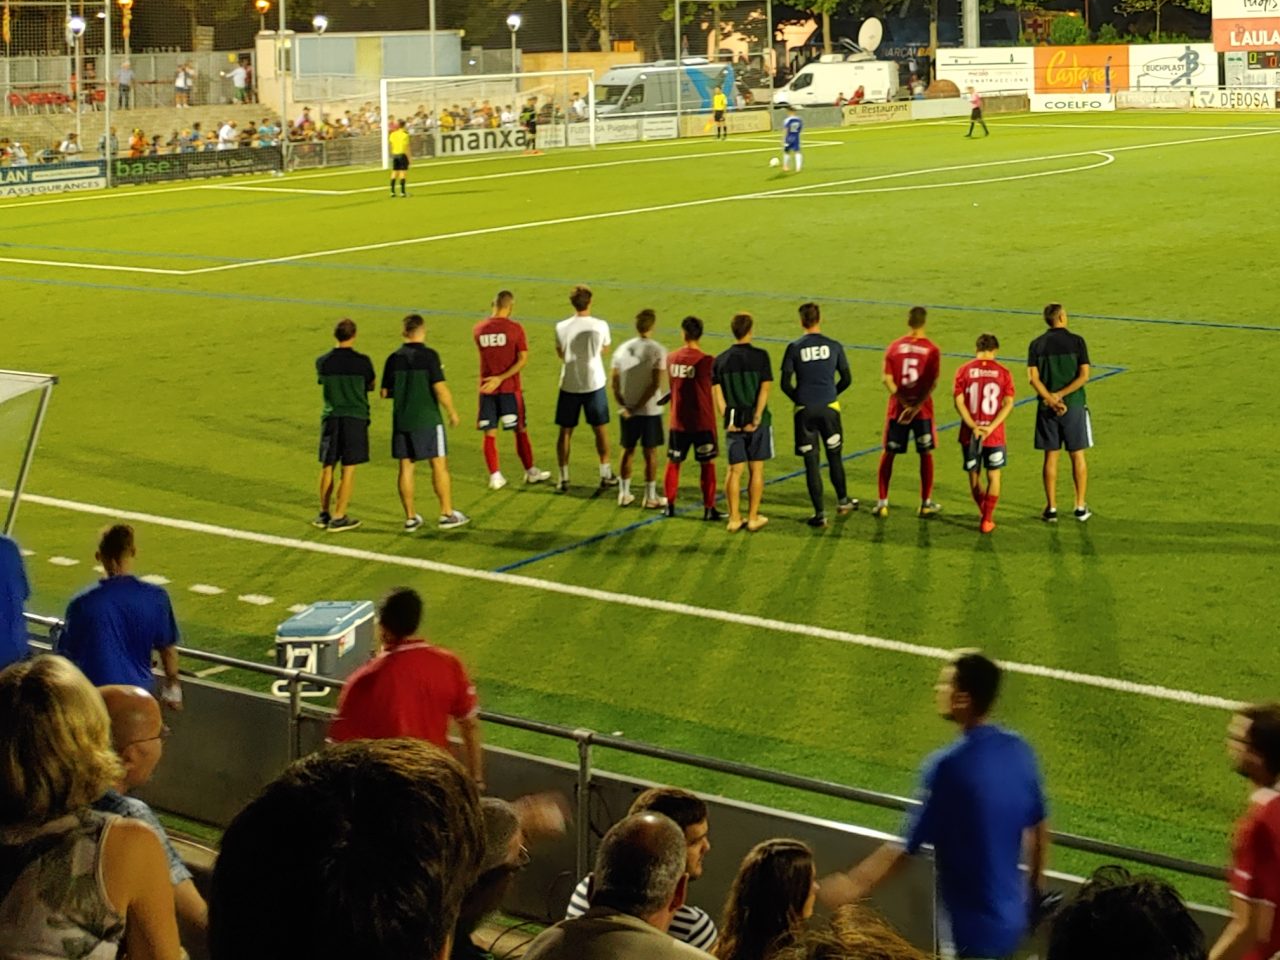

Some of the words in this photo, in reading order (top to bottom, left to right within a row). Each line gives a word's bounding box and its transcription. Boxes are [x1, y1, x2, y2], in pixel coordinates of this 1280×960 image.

[861, 104, 908, 114] Restaurant
[1045, 101, 1102, 110] COELFO
[442, 128, 531, 151] manxa
[902, 358, 920, 385] 5
[966, 382, 1001, 415] 18
